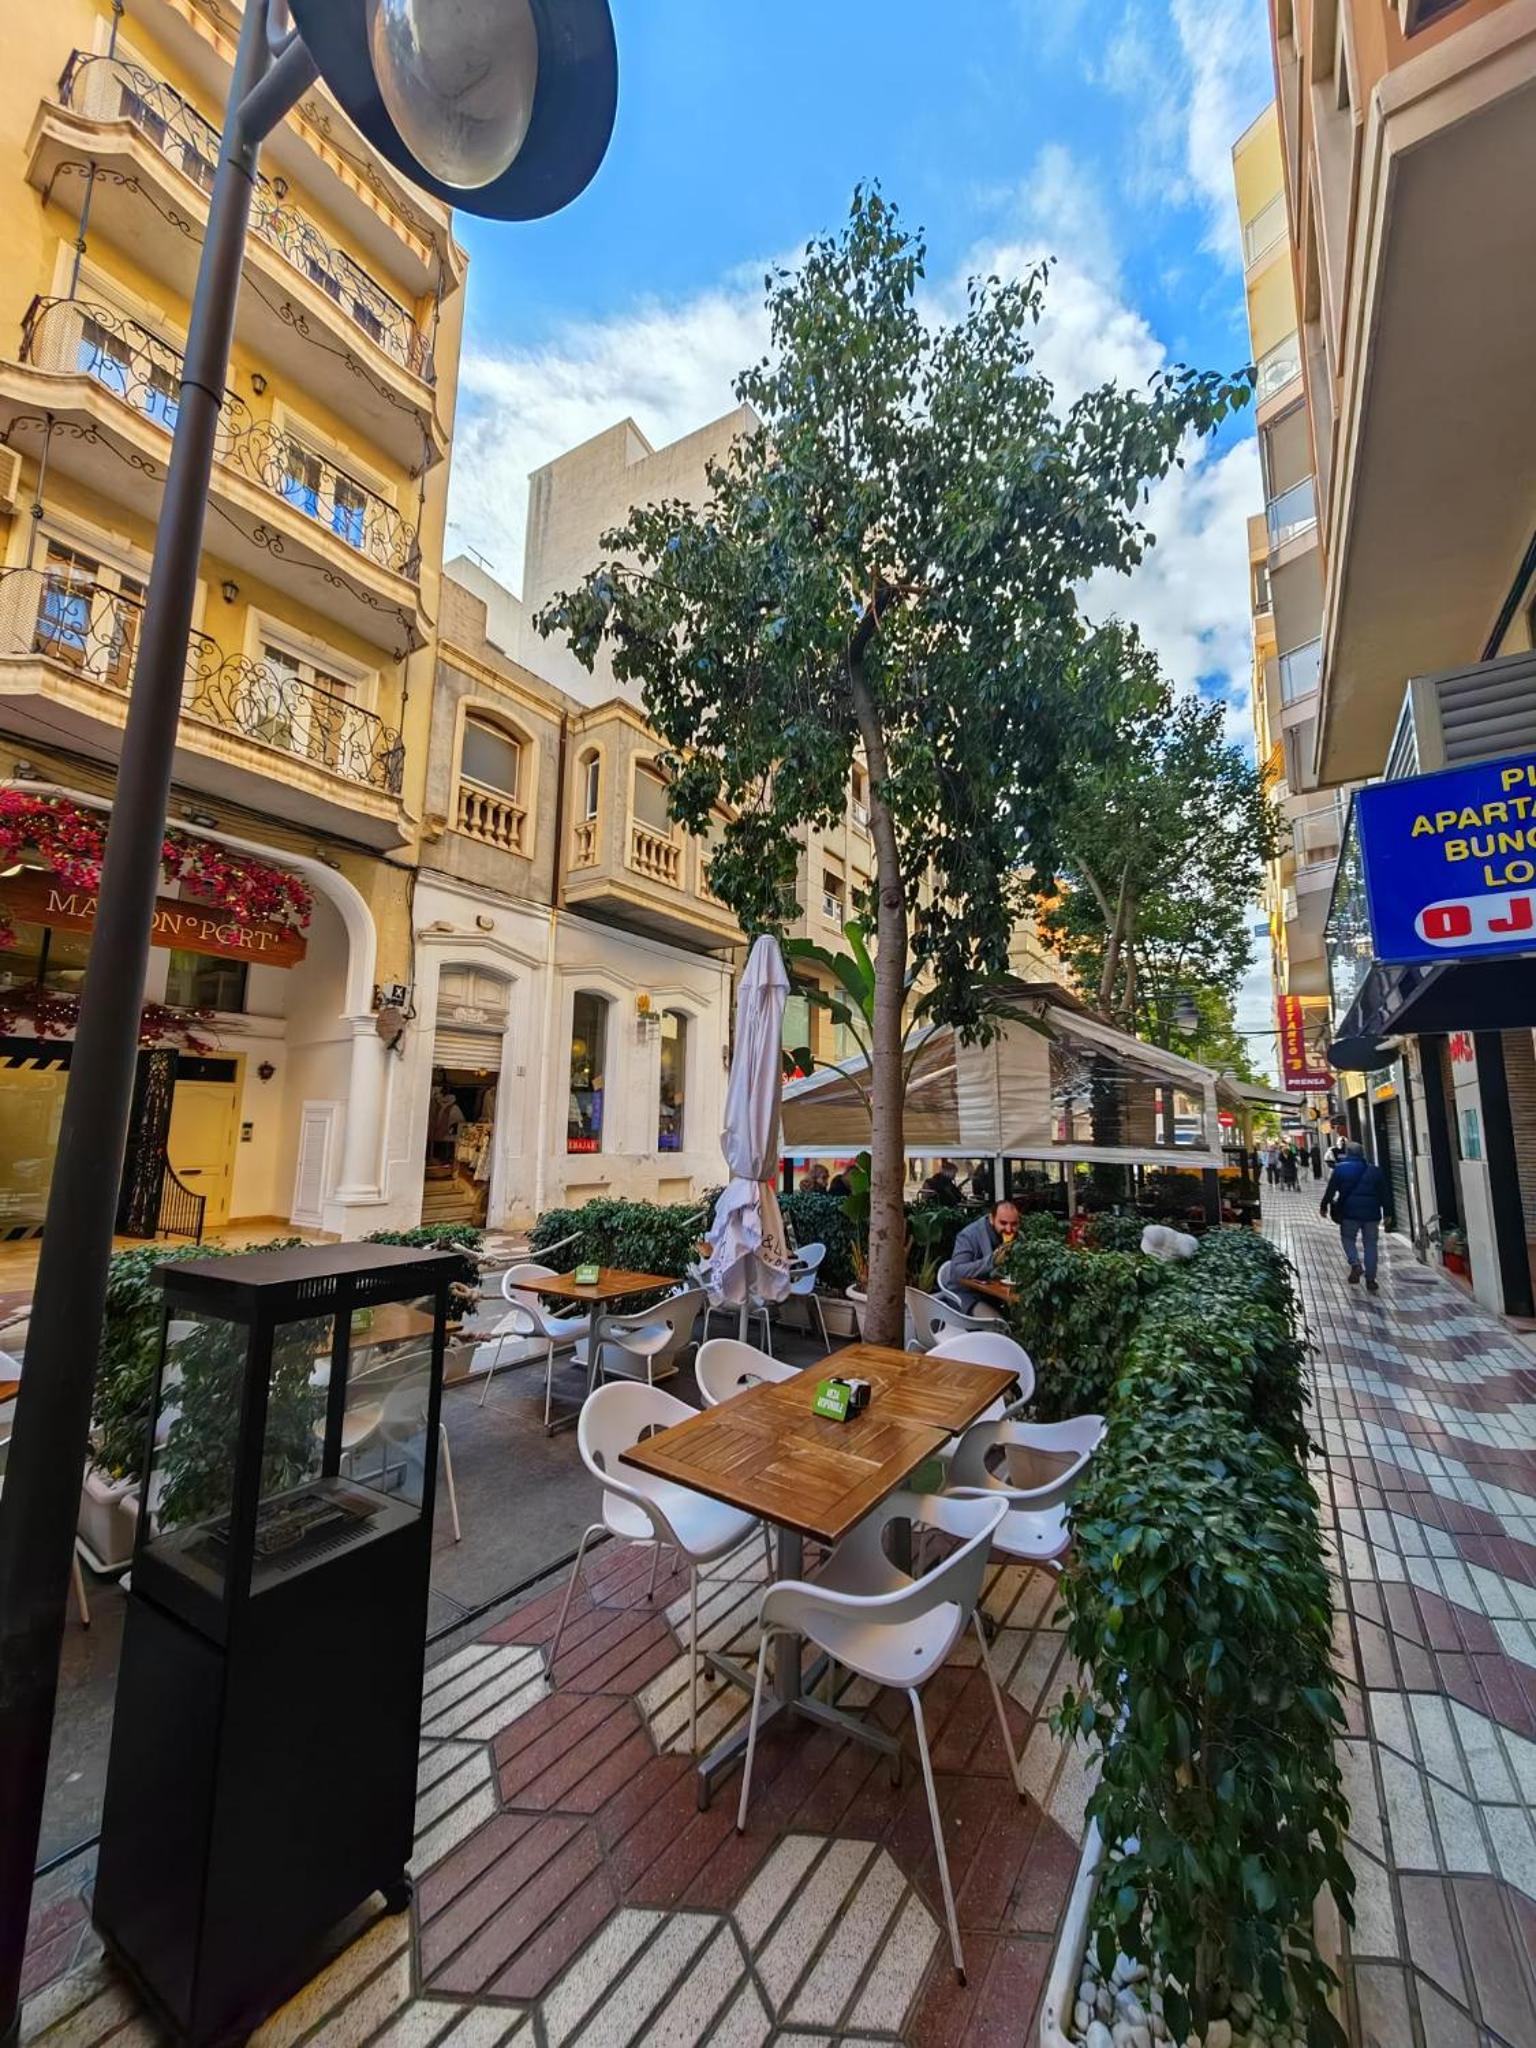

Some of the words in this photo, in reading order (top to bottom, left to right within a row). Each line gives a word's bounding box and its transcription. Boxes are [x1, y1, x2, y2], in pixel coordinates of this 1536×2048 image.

[1411, 796, 1536, 838] APART
[1285, 995, 1299, 1055] ESTANCO
[1288, 1078, 1326, 1086] PRENSA
